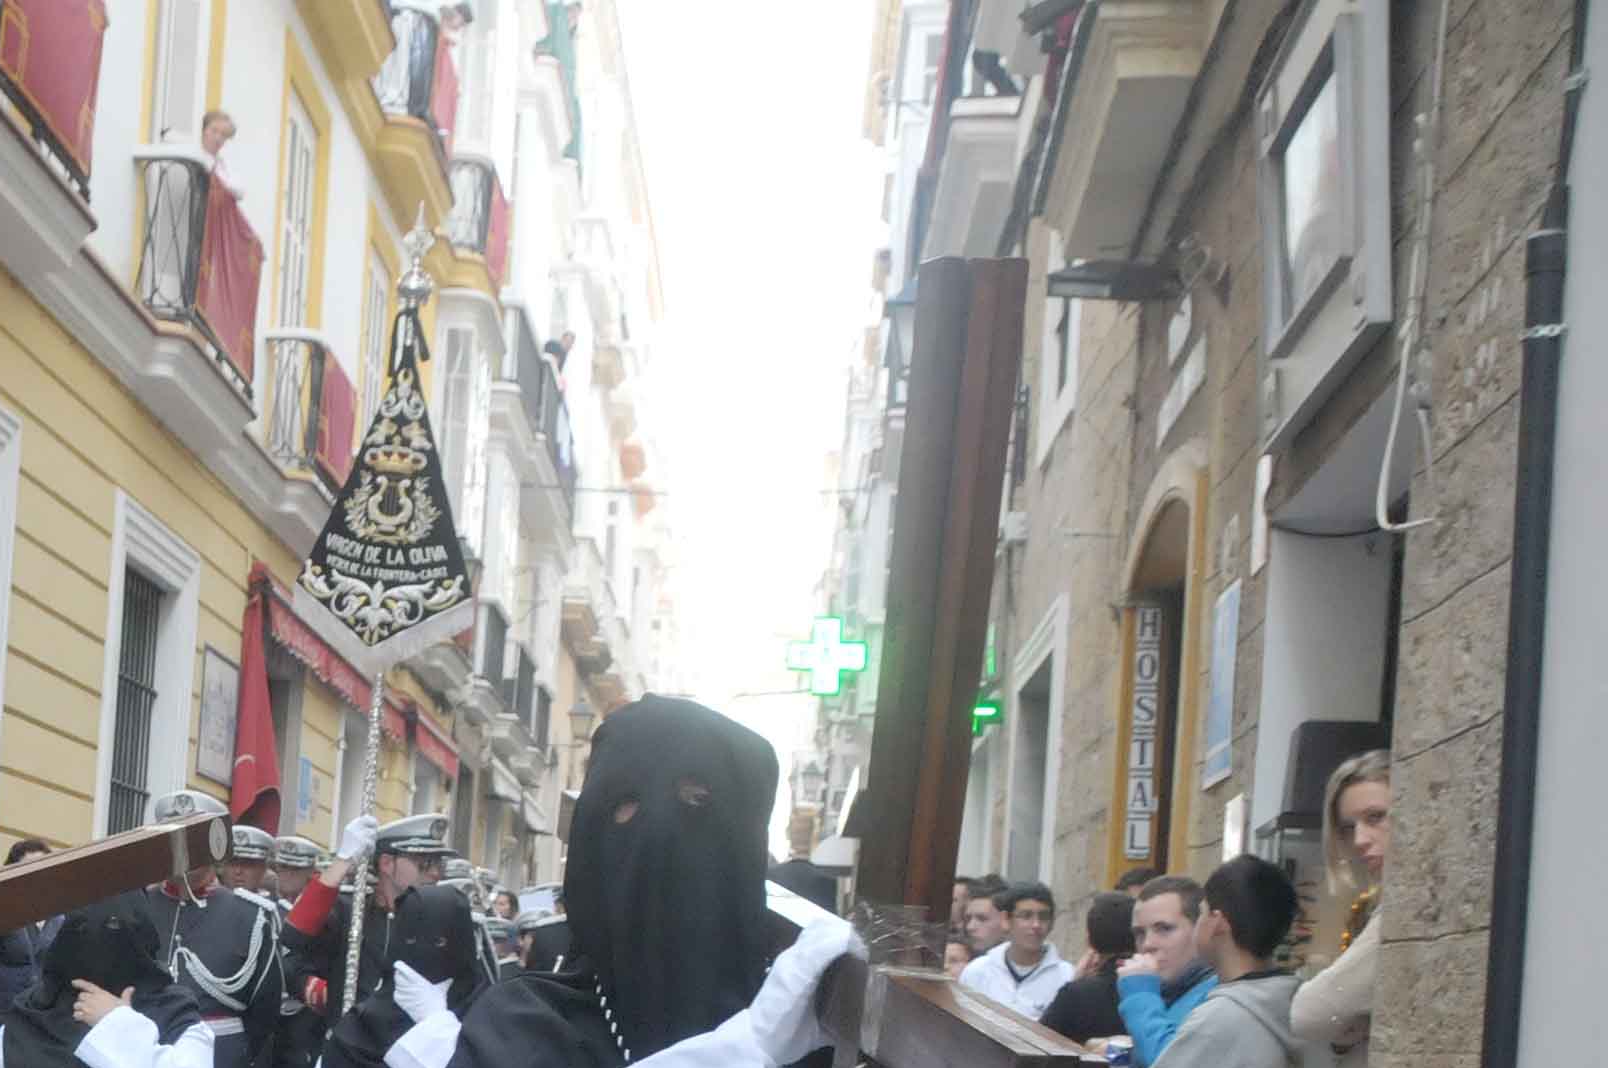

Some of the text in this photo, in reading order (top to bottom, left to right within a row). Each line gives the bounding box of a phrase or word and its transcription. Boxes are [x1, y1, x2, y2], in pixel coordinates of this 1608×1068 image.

[326, 532, 448, 565] VIRGEN DE LA OLIVA
[349, 562, 360, 575] DE
[360, 564, 373, 576] LA
[1129, 609, 1160, 850] HOSTAL
